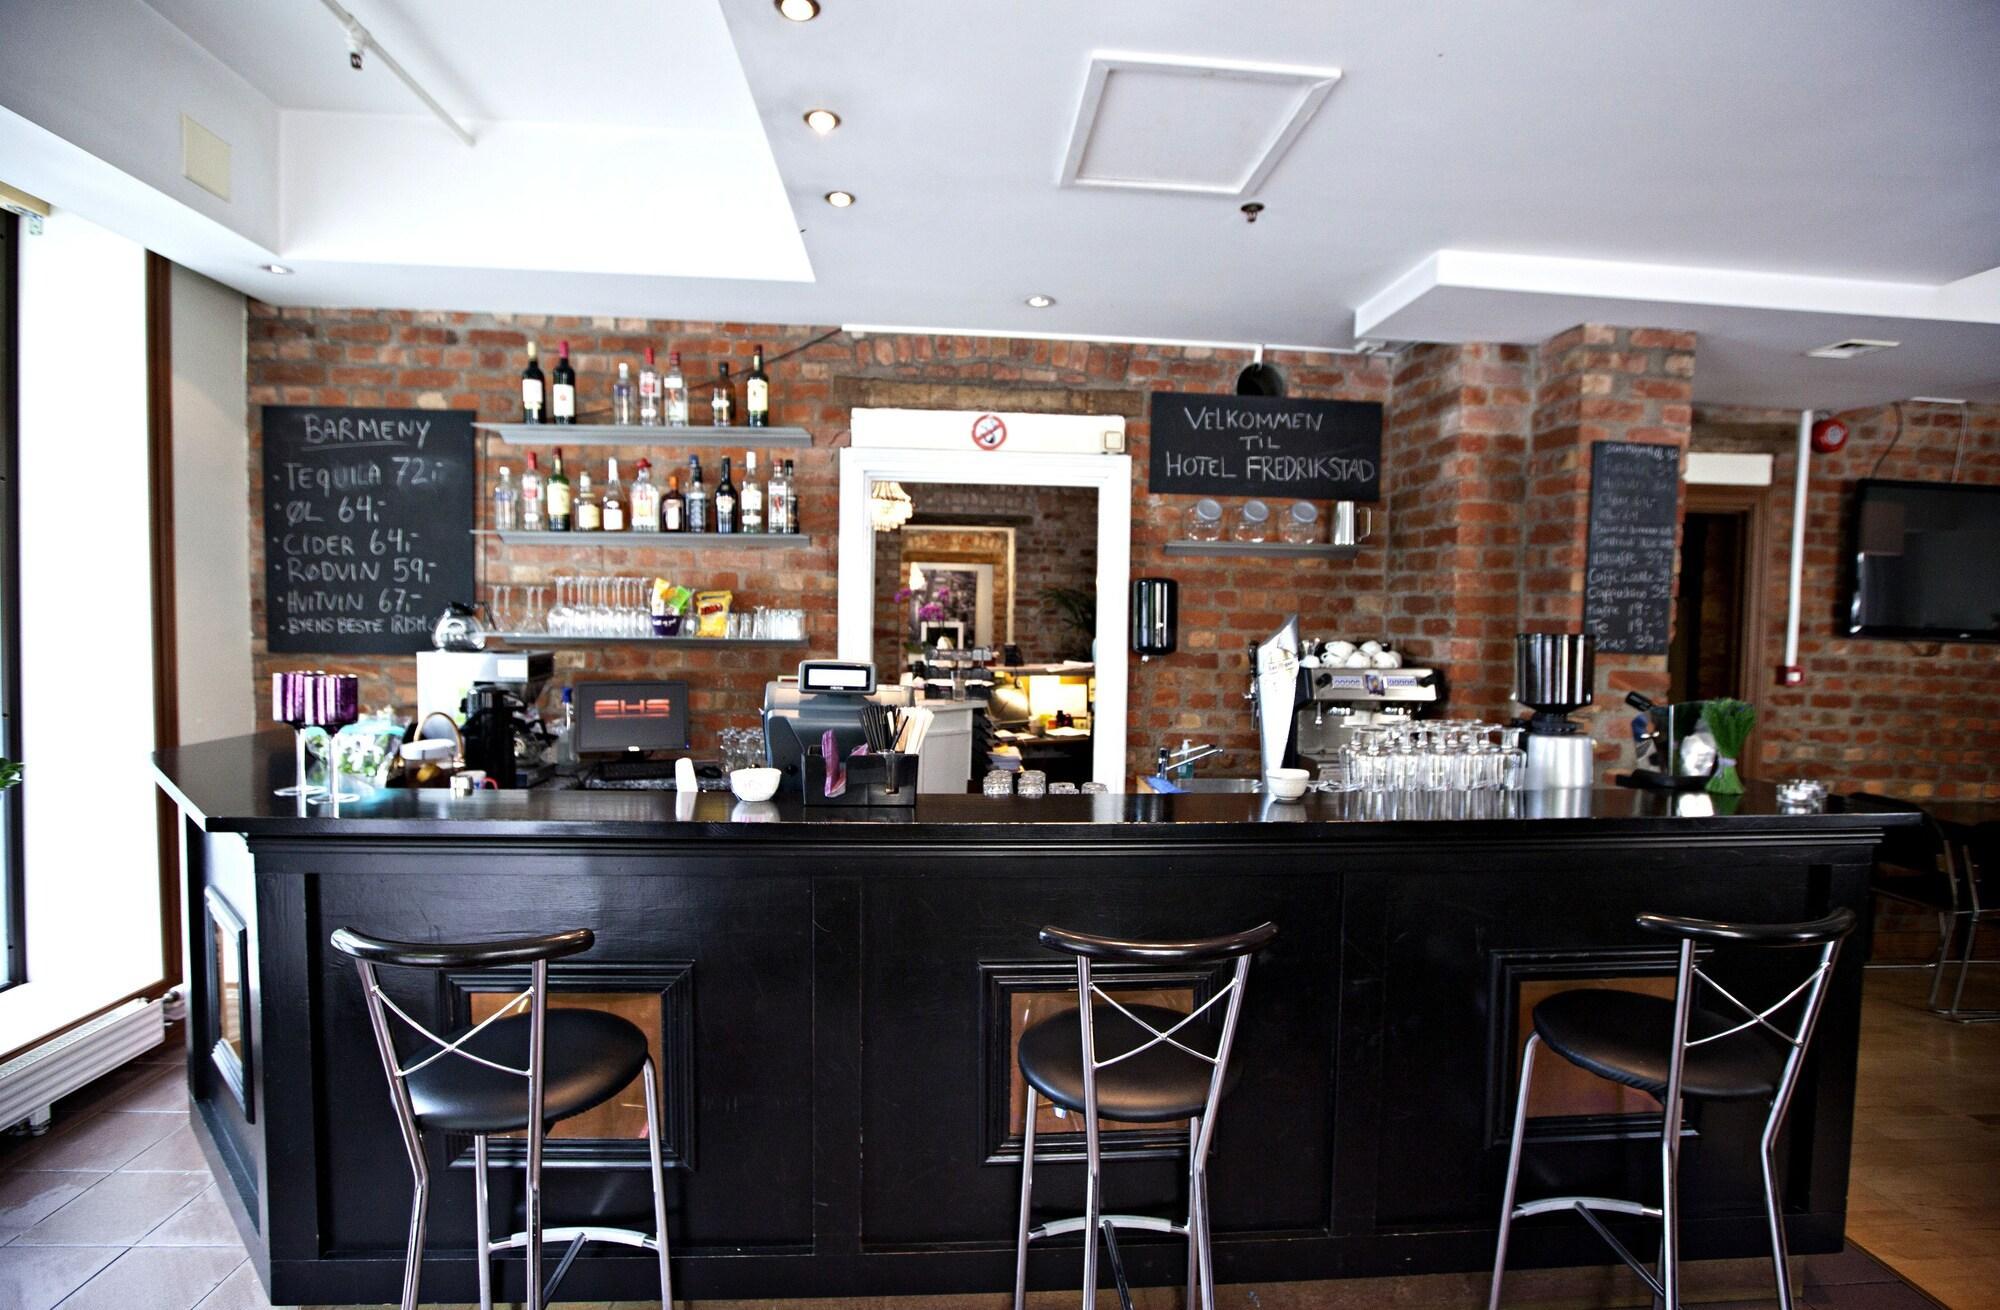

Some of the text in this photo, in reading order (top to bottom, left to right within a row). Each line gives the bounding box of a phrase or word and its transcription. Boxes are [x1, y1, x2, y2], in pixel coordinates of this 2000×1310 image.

[304, 413, 431, 448] BARMENY
[1184, 406, 1324, 432] VELKOMMEN
[1166, 451, 1375, 483] HOTEL FREDRIKSTAD
[286, 500, 324, 527] ØL
[283, 533, 355, 556] CIDER
[287, 589, 364, 614] HVITVIN
[337, 617, 385, 635] BESTE
